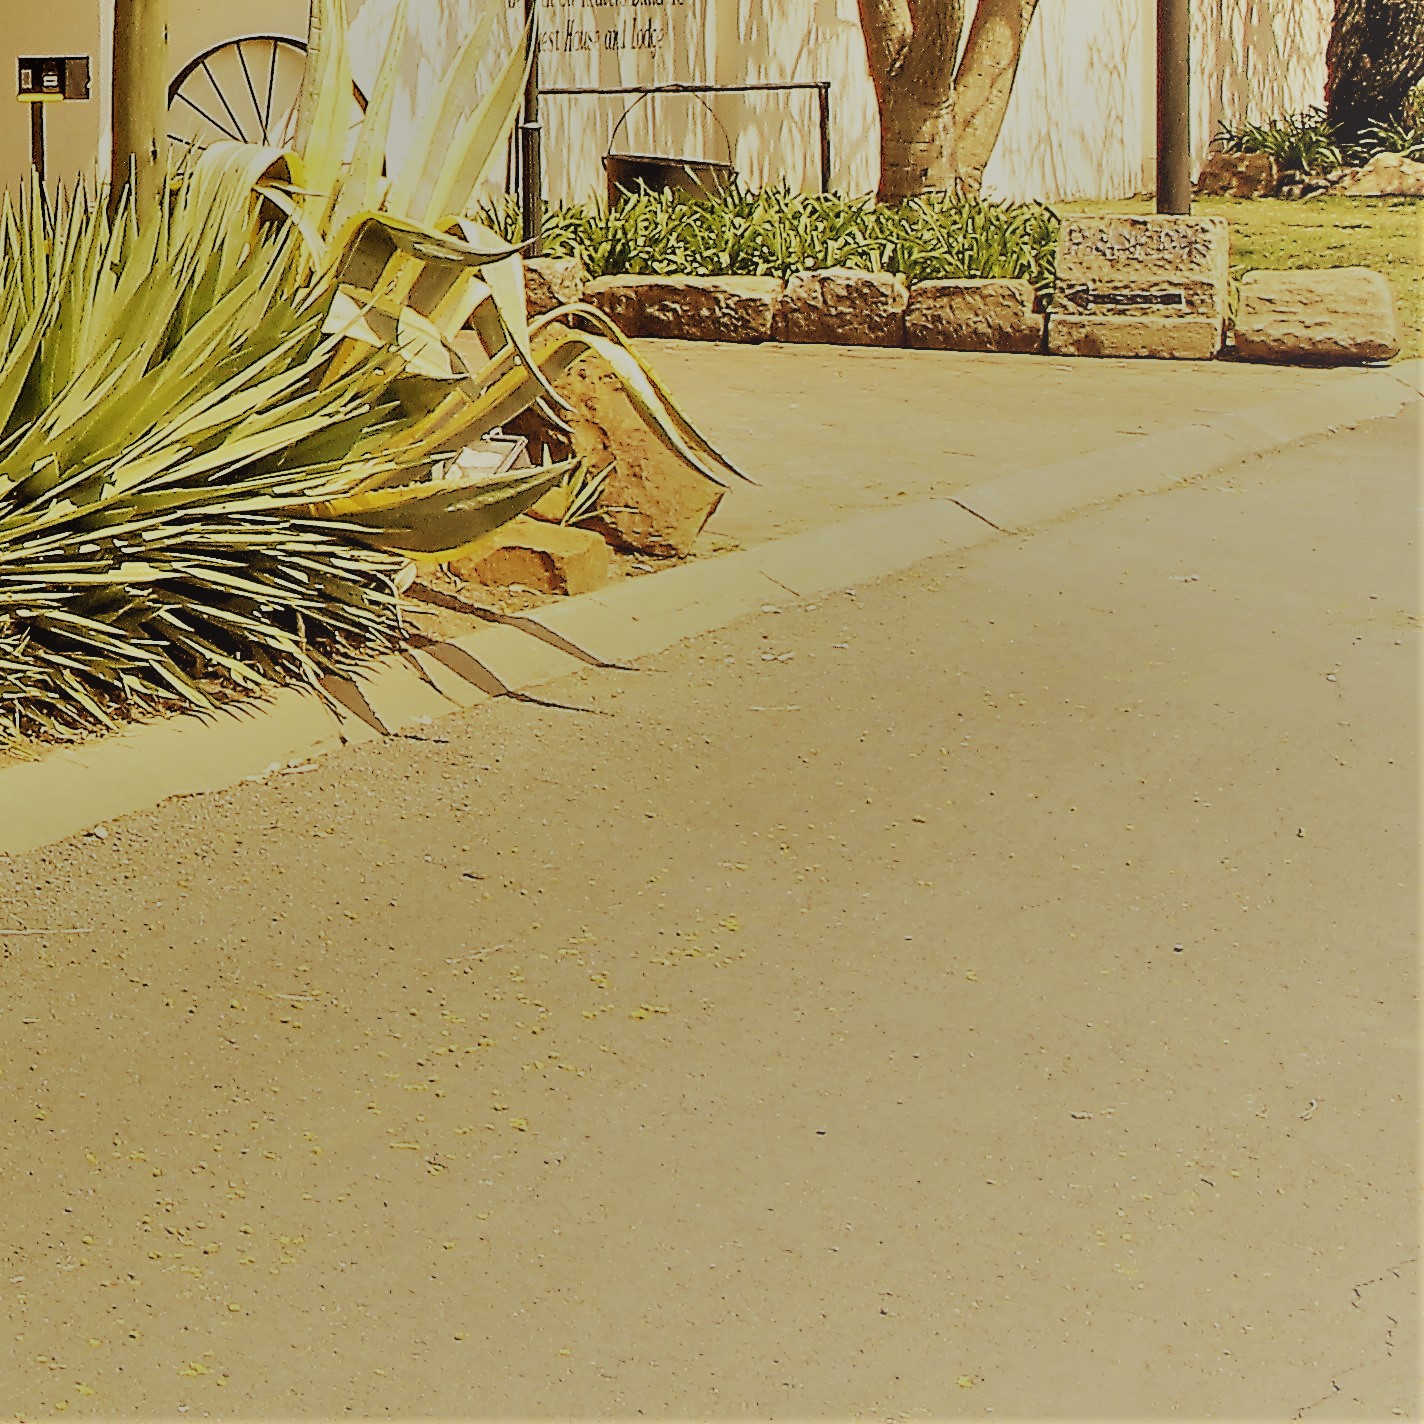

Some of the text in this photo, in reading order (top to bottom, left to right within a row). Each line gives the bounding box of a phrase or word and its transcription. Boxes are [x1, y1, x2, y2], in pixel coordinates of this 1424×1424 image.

[564, 19, 601, 52] House
[605, 20, 626, 50] and
[631, 17, 665, 59] Lodge
